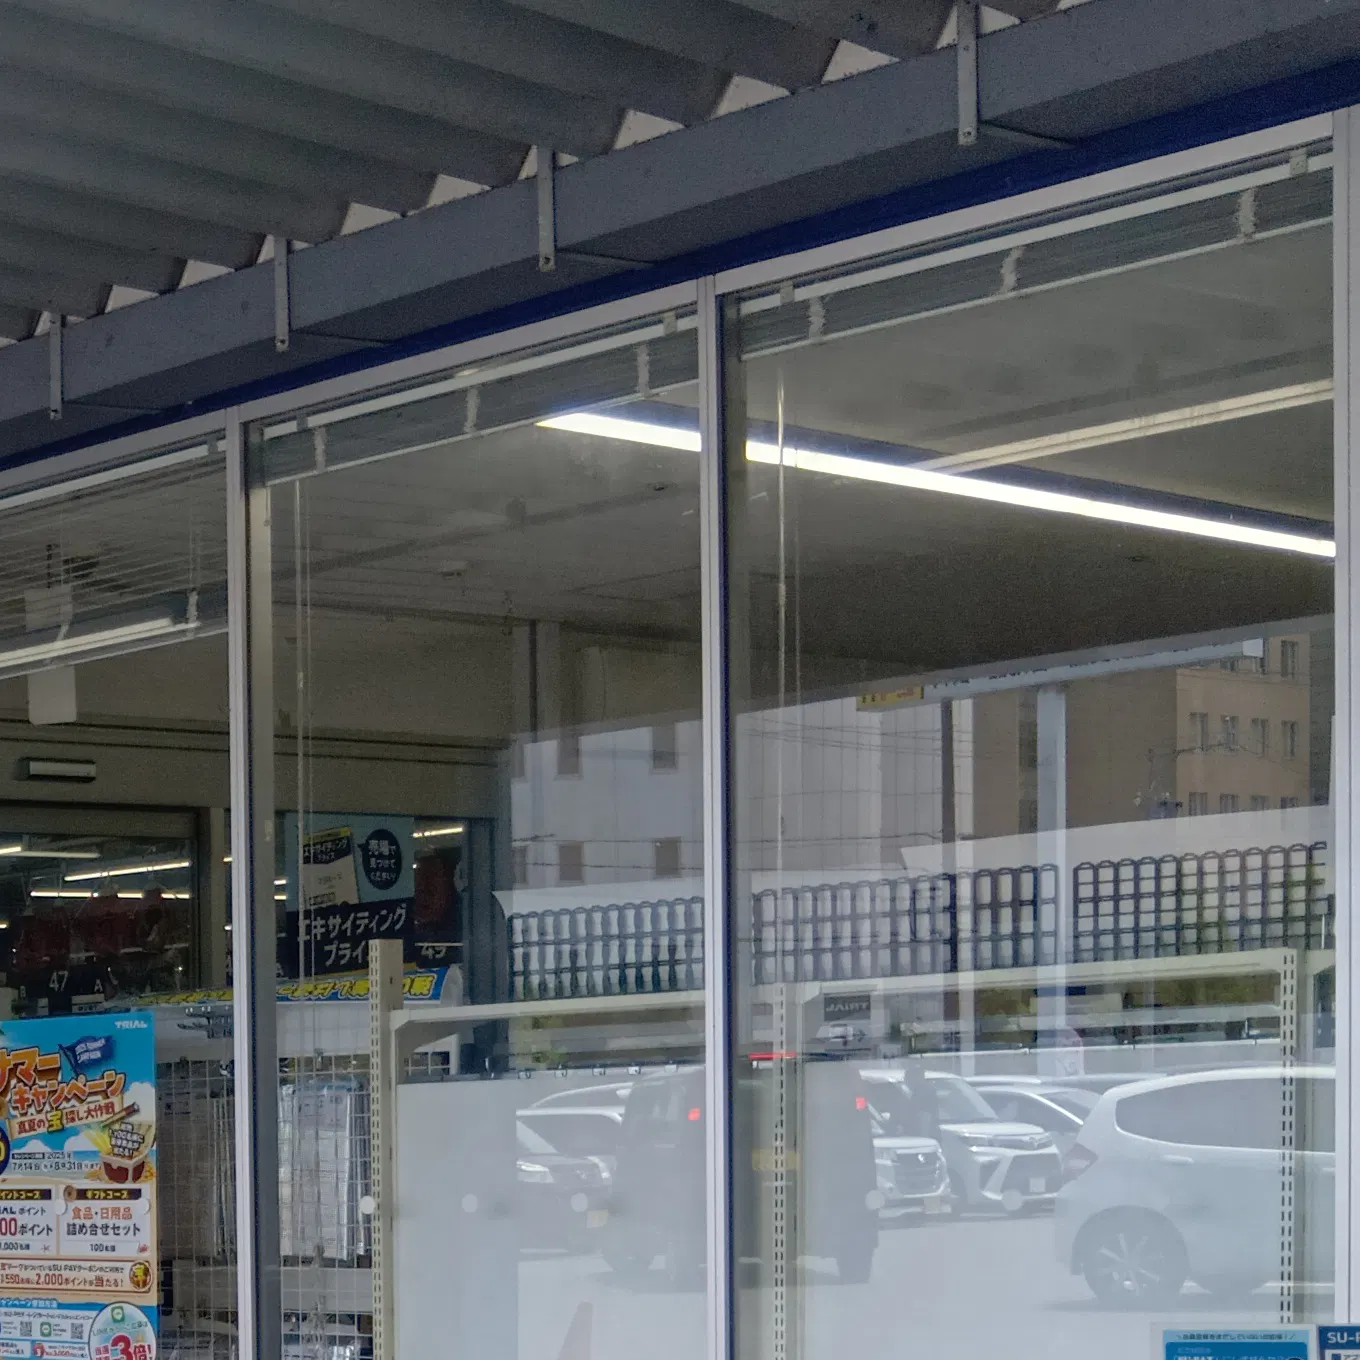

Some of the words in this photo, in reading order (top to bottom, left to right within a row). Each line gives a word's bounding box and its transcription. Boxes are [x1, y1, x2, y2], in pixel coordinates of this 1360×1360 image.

[298, 903, 408, 942] エキサイティング
[115, 1020, 148, 1030] TRIAL
[11, 1069, 126, 1113] キャンペーン
[72, 1206, 133, 1220] 食品・日用品
